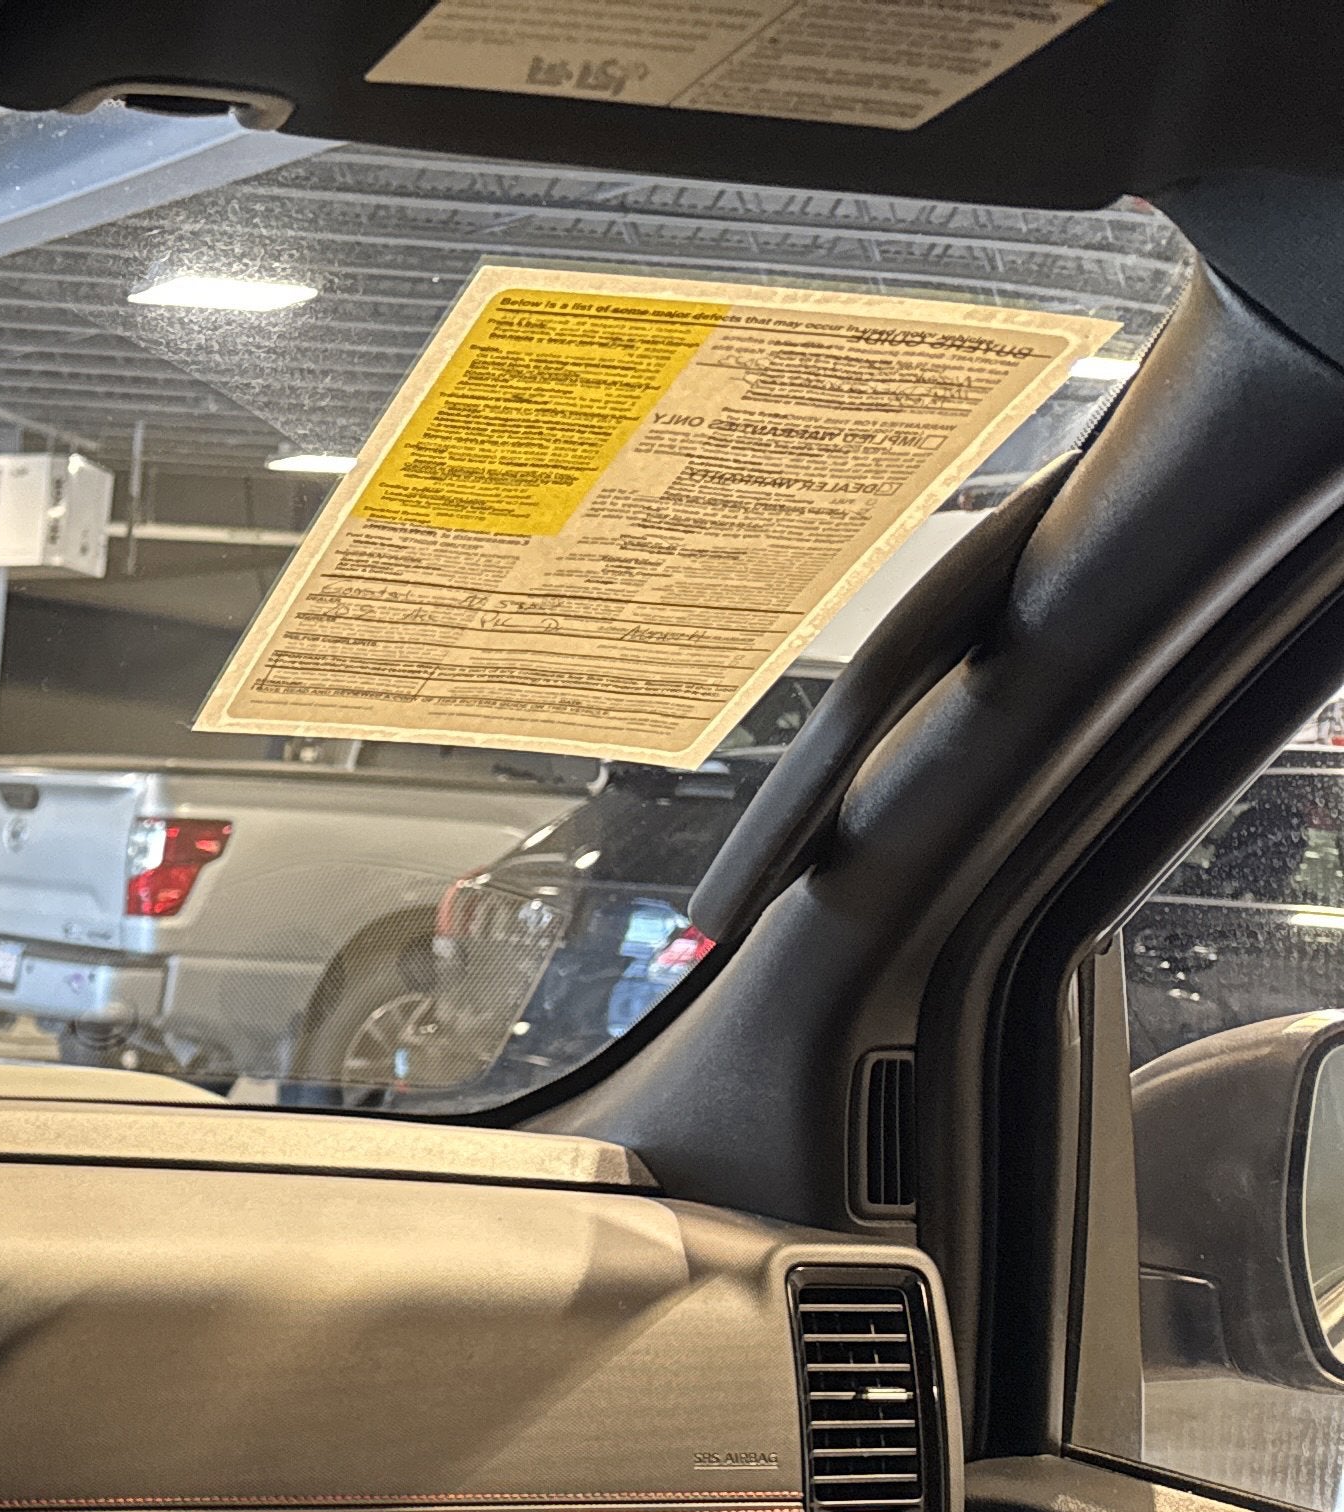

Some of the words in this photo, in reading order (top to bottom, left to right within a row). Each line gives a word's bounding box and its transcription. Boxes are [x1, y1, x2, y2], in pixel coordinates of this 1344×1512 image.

[499, 297, 542, 309] Below
[544, 300, 555, 309] is
[571, 302, 593, 311] list
[596, 304, 610, 313] of
[612, 306, 649, 316] some
[651, 308, 691, 320] major
[693, 310, 741, 322] defects
[745, 315, 772, 326] that
[773, 319, 802, 329] may
[805, 322, 843, 332] occur
[694, 1452, 720, 1464] SRS
[724, 1452, 779, 1465] AIRBAG
